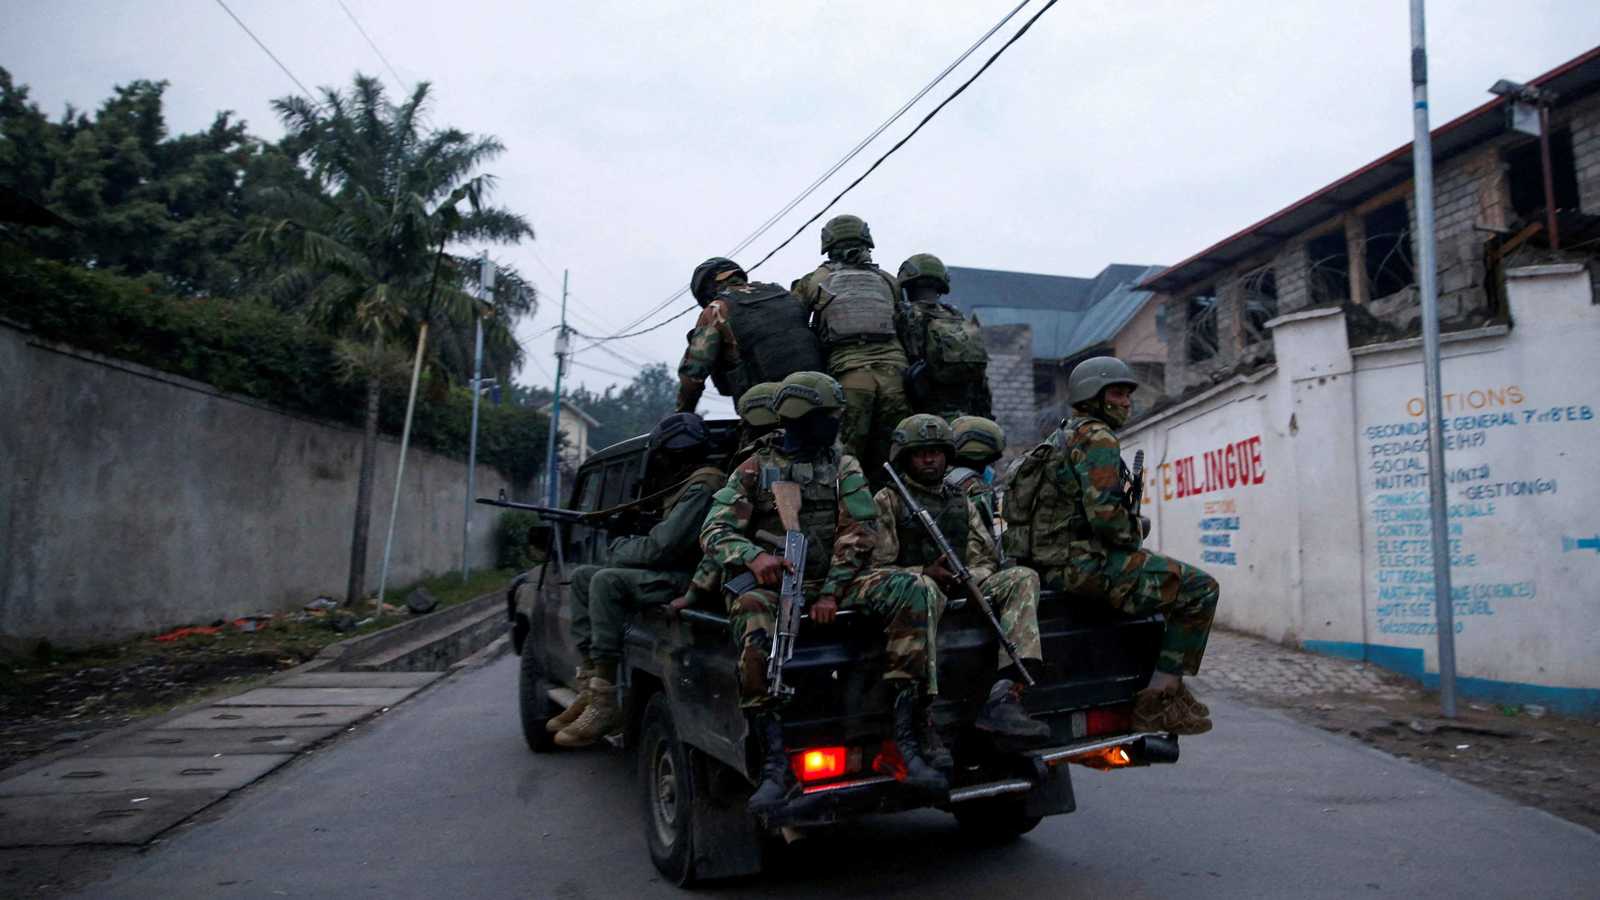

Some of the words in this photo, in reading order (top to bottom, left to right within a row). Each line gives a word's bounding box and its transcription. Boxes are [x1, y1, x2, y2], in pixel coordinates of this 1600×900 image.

[1407, 385, 1526, 417] OTIONS
[1454, 412, 1519, 431] GENERAL
[1175, 435, 1265, 498] BILINGUE
